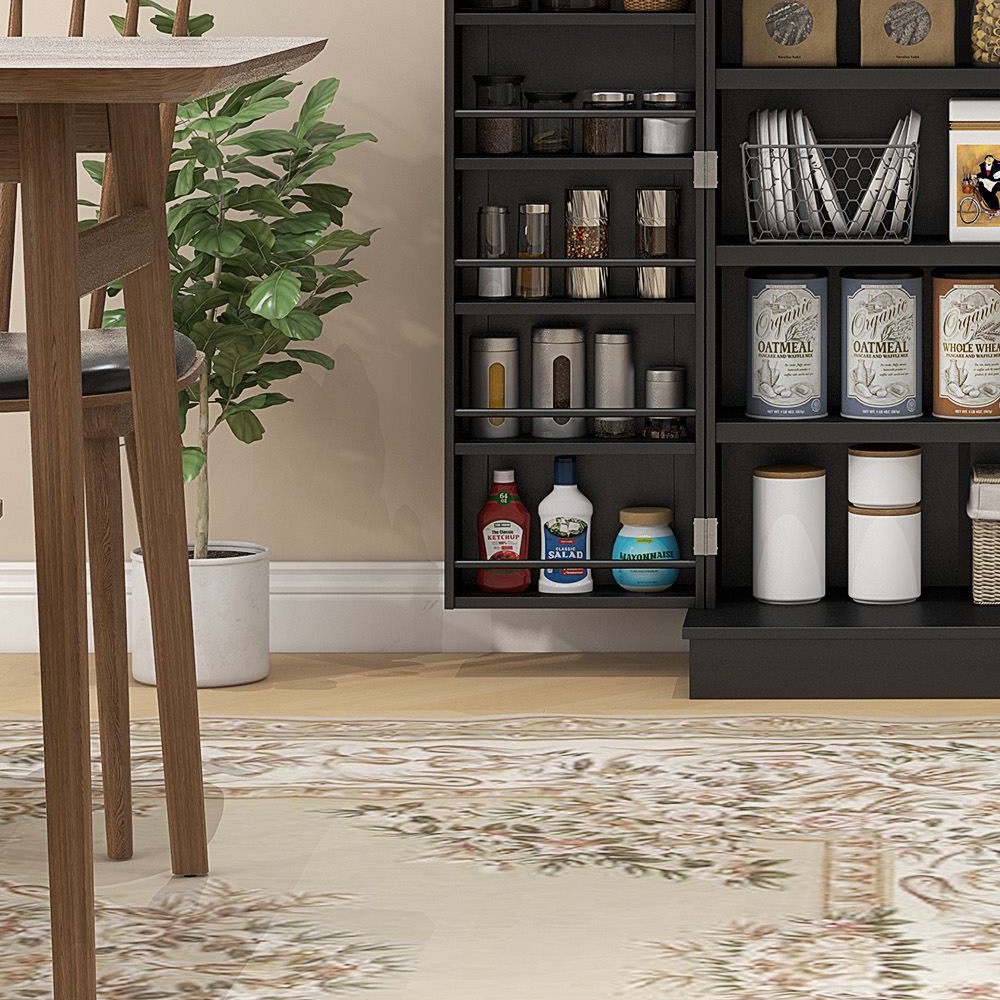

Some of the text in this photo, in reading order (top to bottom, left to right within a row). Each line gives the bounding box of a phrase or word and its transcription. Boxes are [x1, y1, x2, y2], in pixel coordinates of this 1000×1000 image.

[756, 298, 812, 340] Organic
[851, 298, 908, 340] Organic
[943, 298, 1000, 340] Organic
[757, 341, 813, 354] OATMEAL
[853, 341, 909, 354] OATMEAL
[942, 342, 974, 353] WHOLE
[548, 551, 584, 559] SALAD
[619, 550, 674, 560] MAYONNAISE
